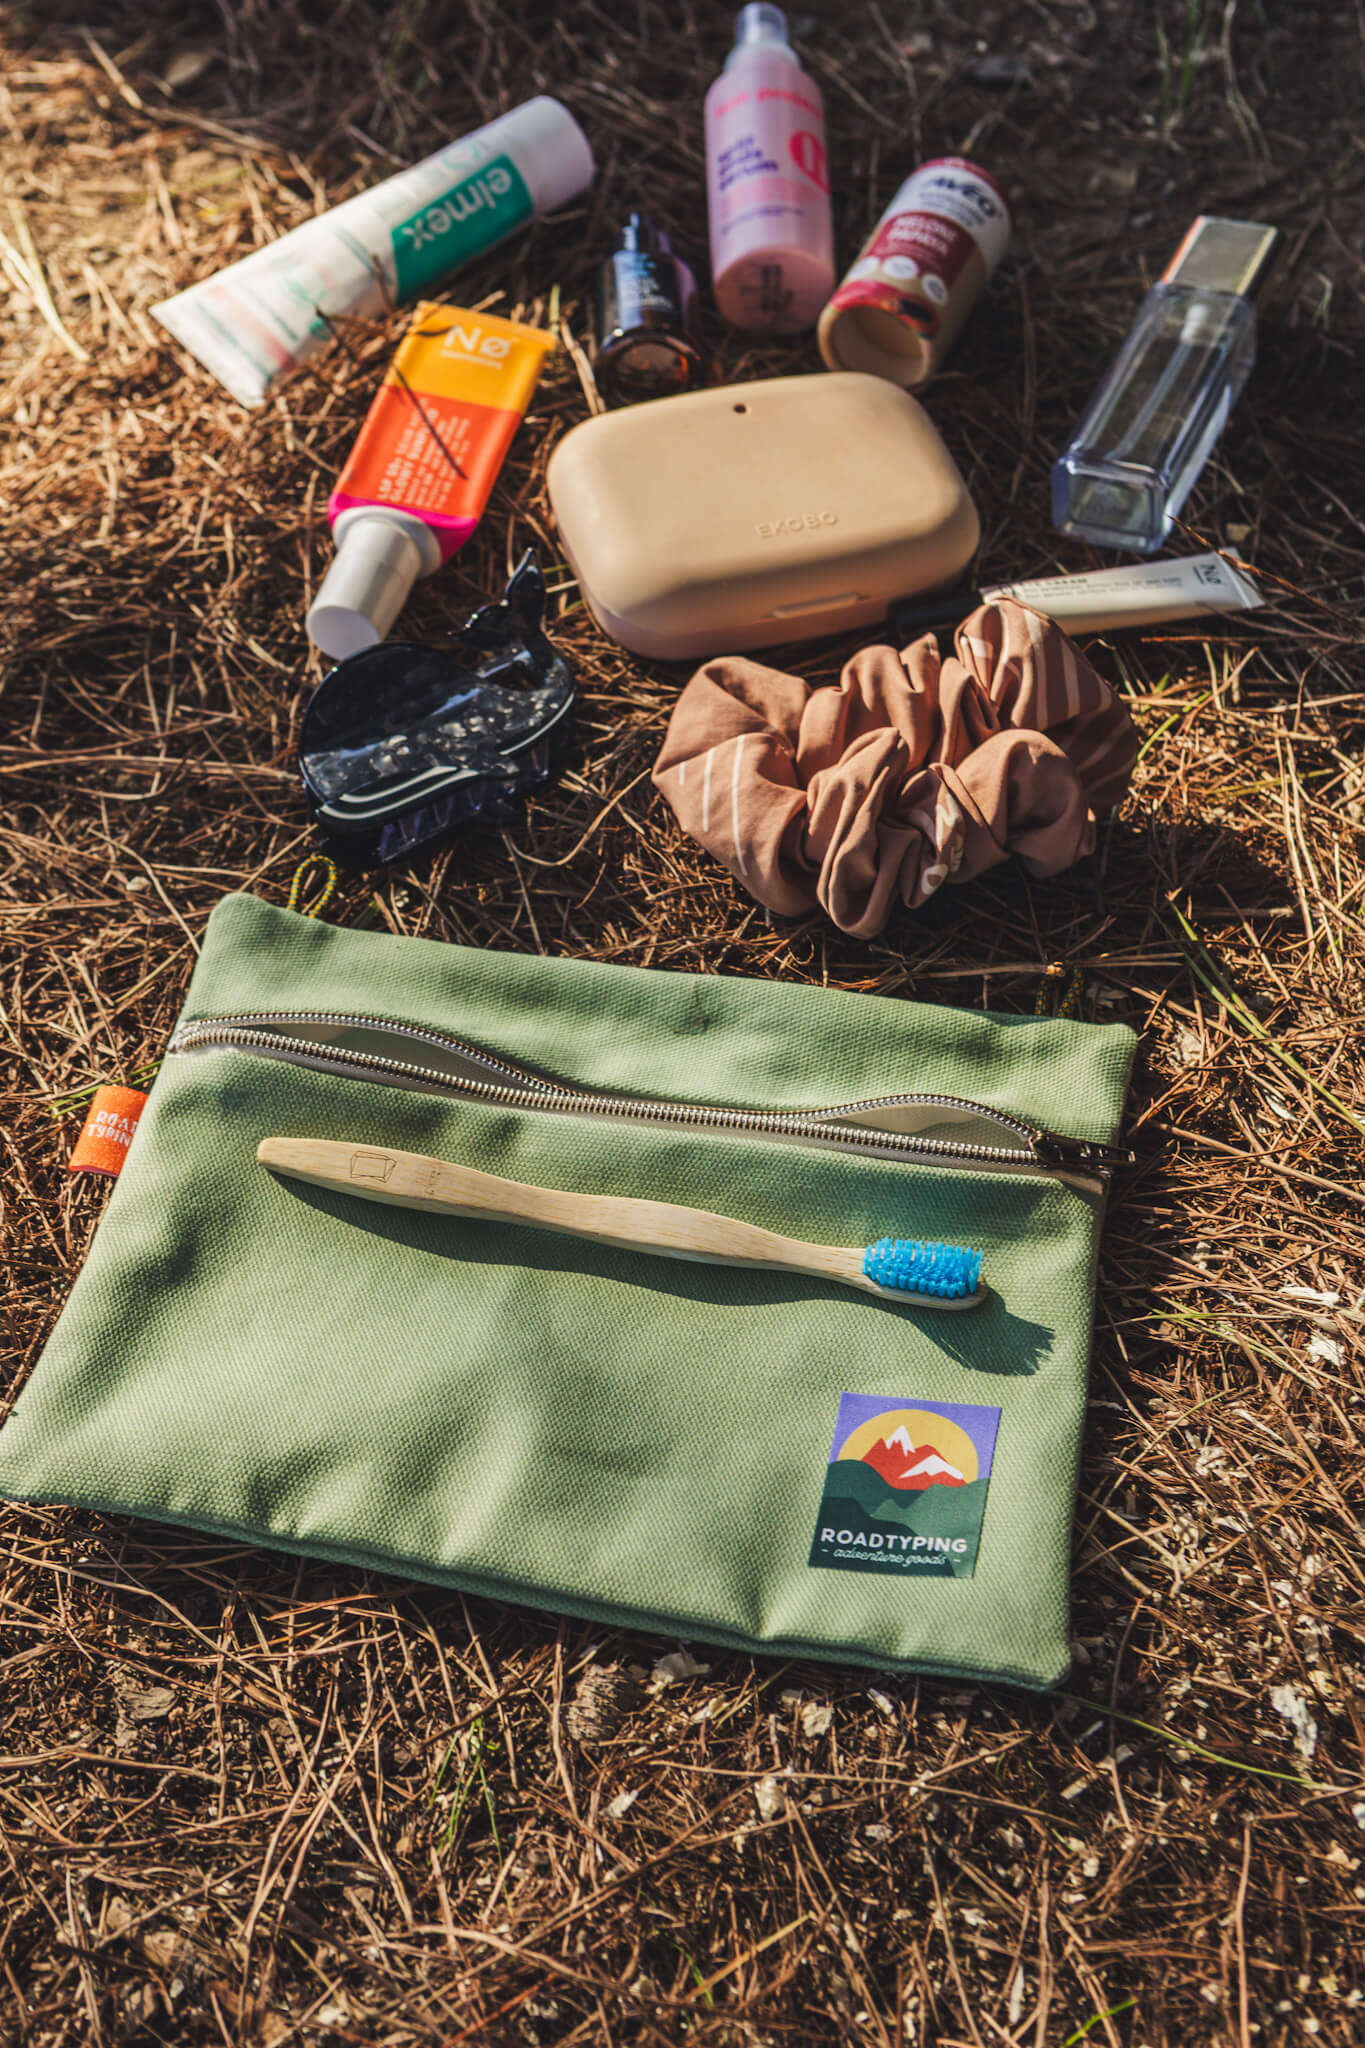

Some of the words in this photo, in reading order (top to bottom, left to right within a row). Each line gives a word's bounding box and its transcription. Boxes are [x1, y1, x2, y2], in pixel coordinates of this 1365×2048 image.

[401, 167, 513, 249] elmex
[753, 511, 839, 539] EKOBO
[820, 1528, 968, 1553] ROADTYPING
[833, 1547, 904, 1564] adventure
[902, 1553, 948, 1567] goods
